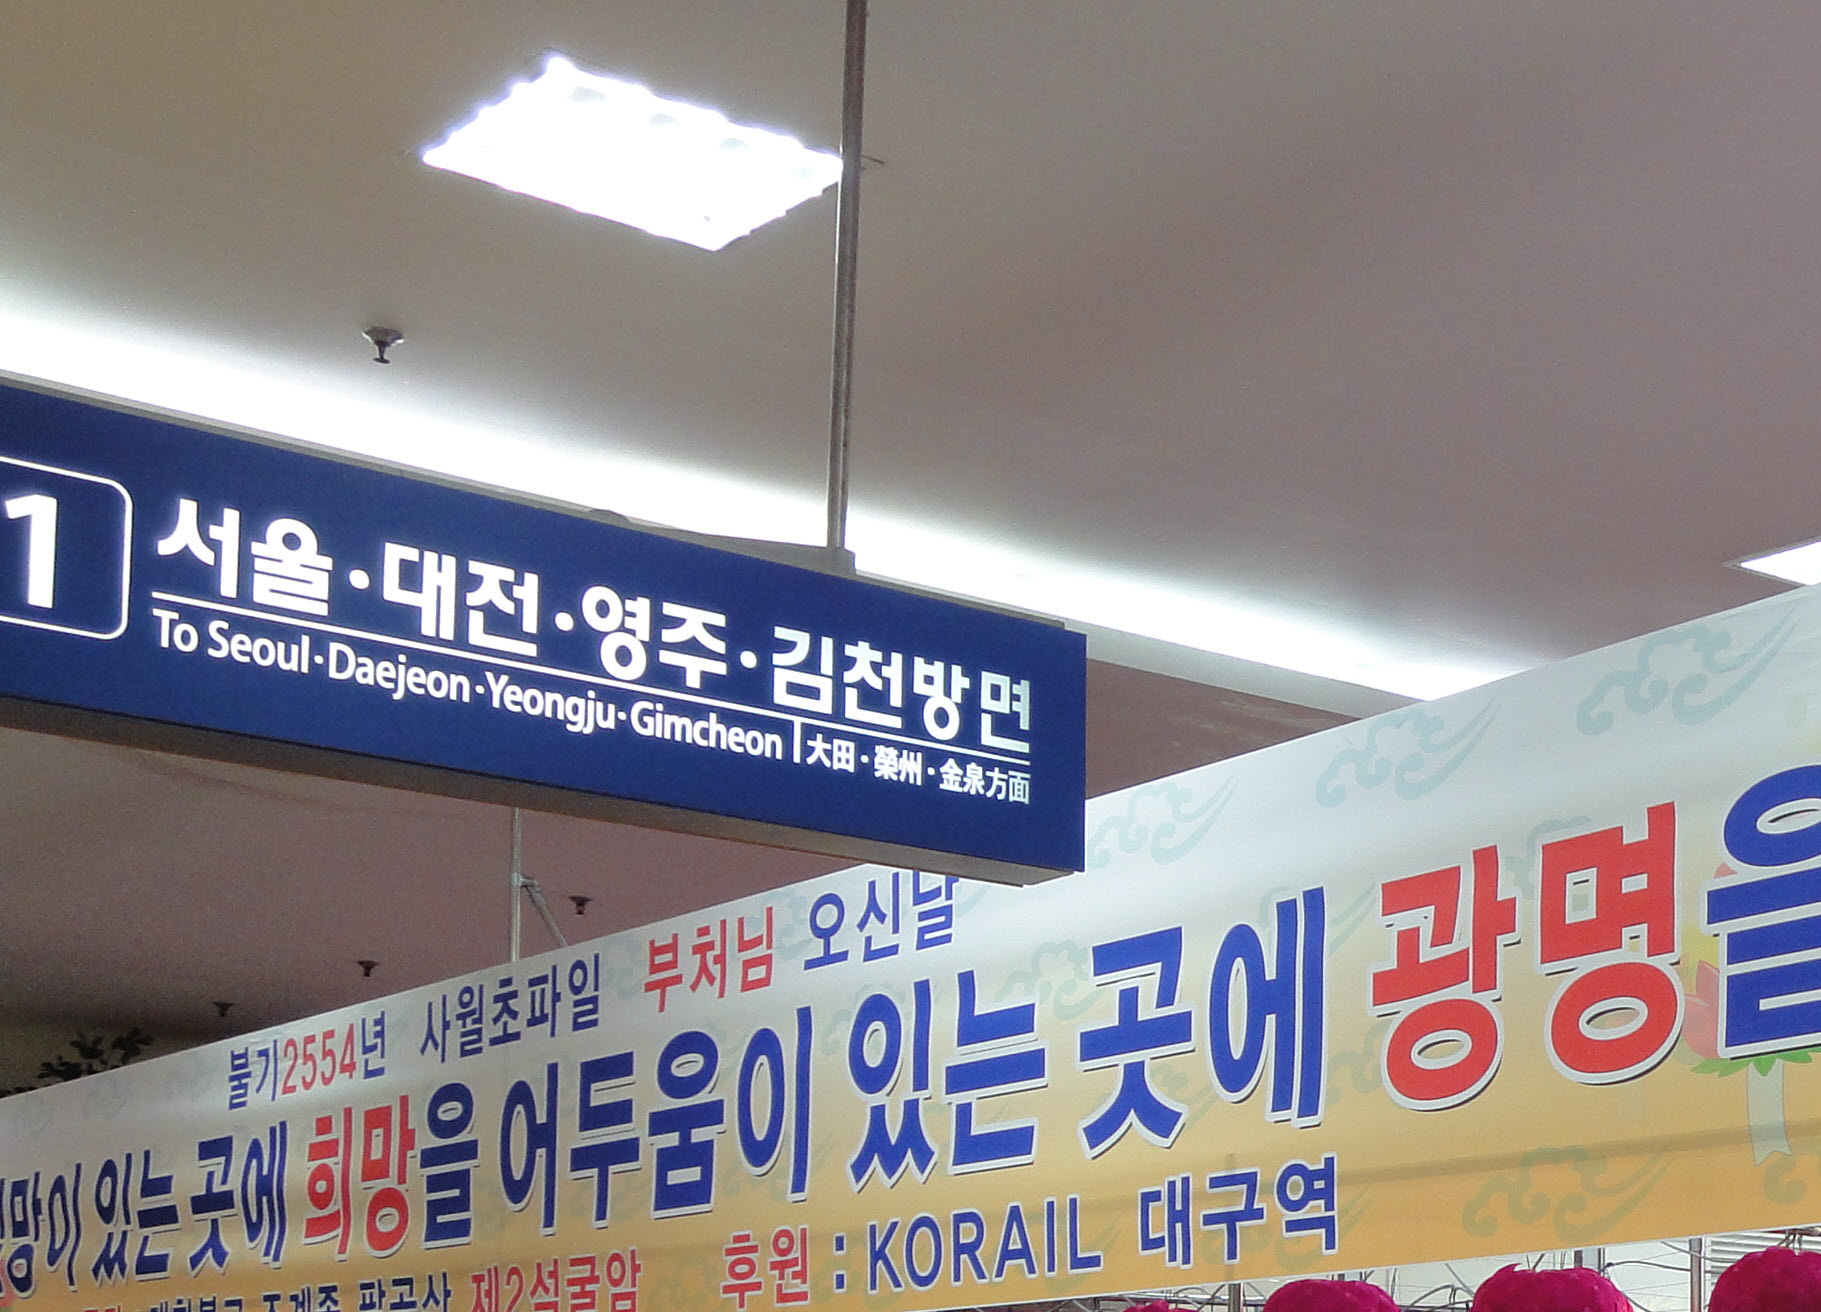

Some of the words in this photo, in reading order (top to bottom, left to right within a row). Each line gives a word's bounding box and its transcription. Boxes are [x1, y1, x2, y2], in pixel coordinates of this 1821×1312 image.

[5, 494, 58, 610] 1
[152, 607, 198, 654] To
[228, 1010, 386, 1110] 불기2554년
[420, 953, 601, 1064] 사월초파일
[643, 905, 775, 1014] 부처님
[803, 869, 960, 971] 오신날
[0, 1161, 82, 1296] 망이
[92, 1149, 175, 1285] 있는
[189, 1121, 287, 1277] 곳에
[303, 1082, 480, 1260] 희망을
[501, 1005, 812, 1235] 어두움이
[848, 969, 1047, 1190] 있는
[1078, 886, 1327, 1160] 곳에
[721, 1227, 810, 1309] 후원
[867, 1197, 1102, 1294] KORAIL
[1138, 1153, 1337, 1267] 대구역
